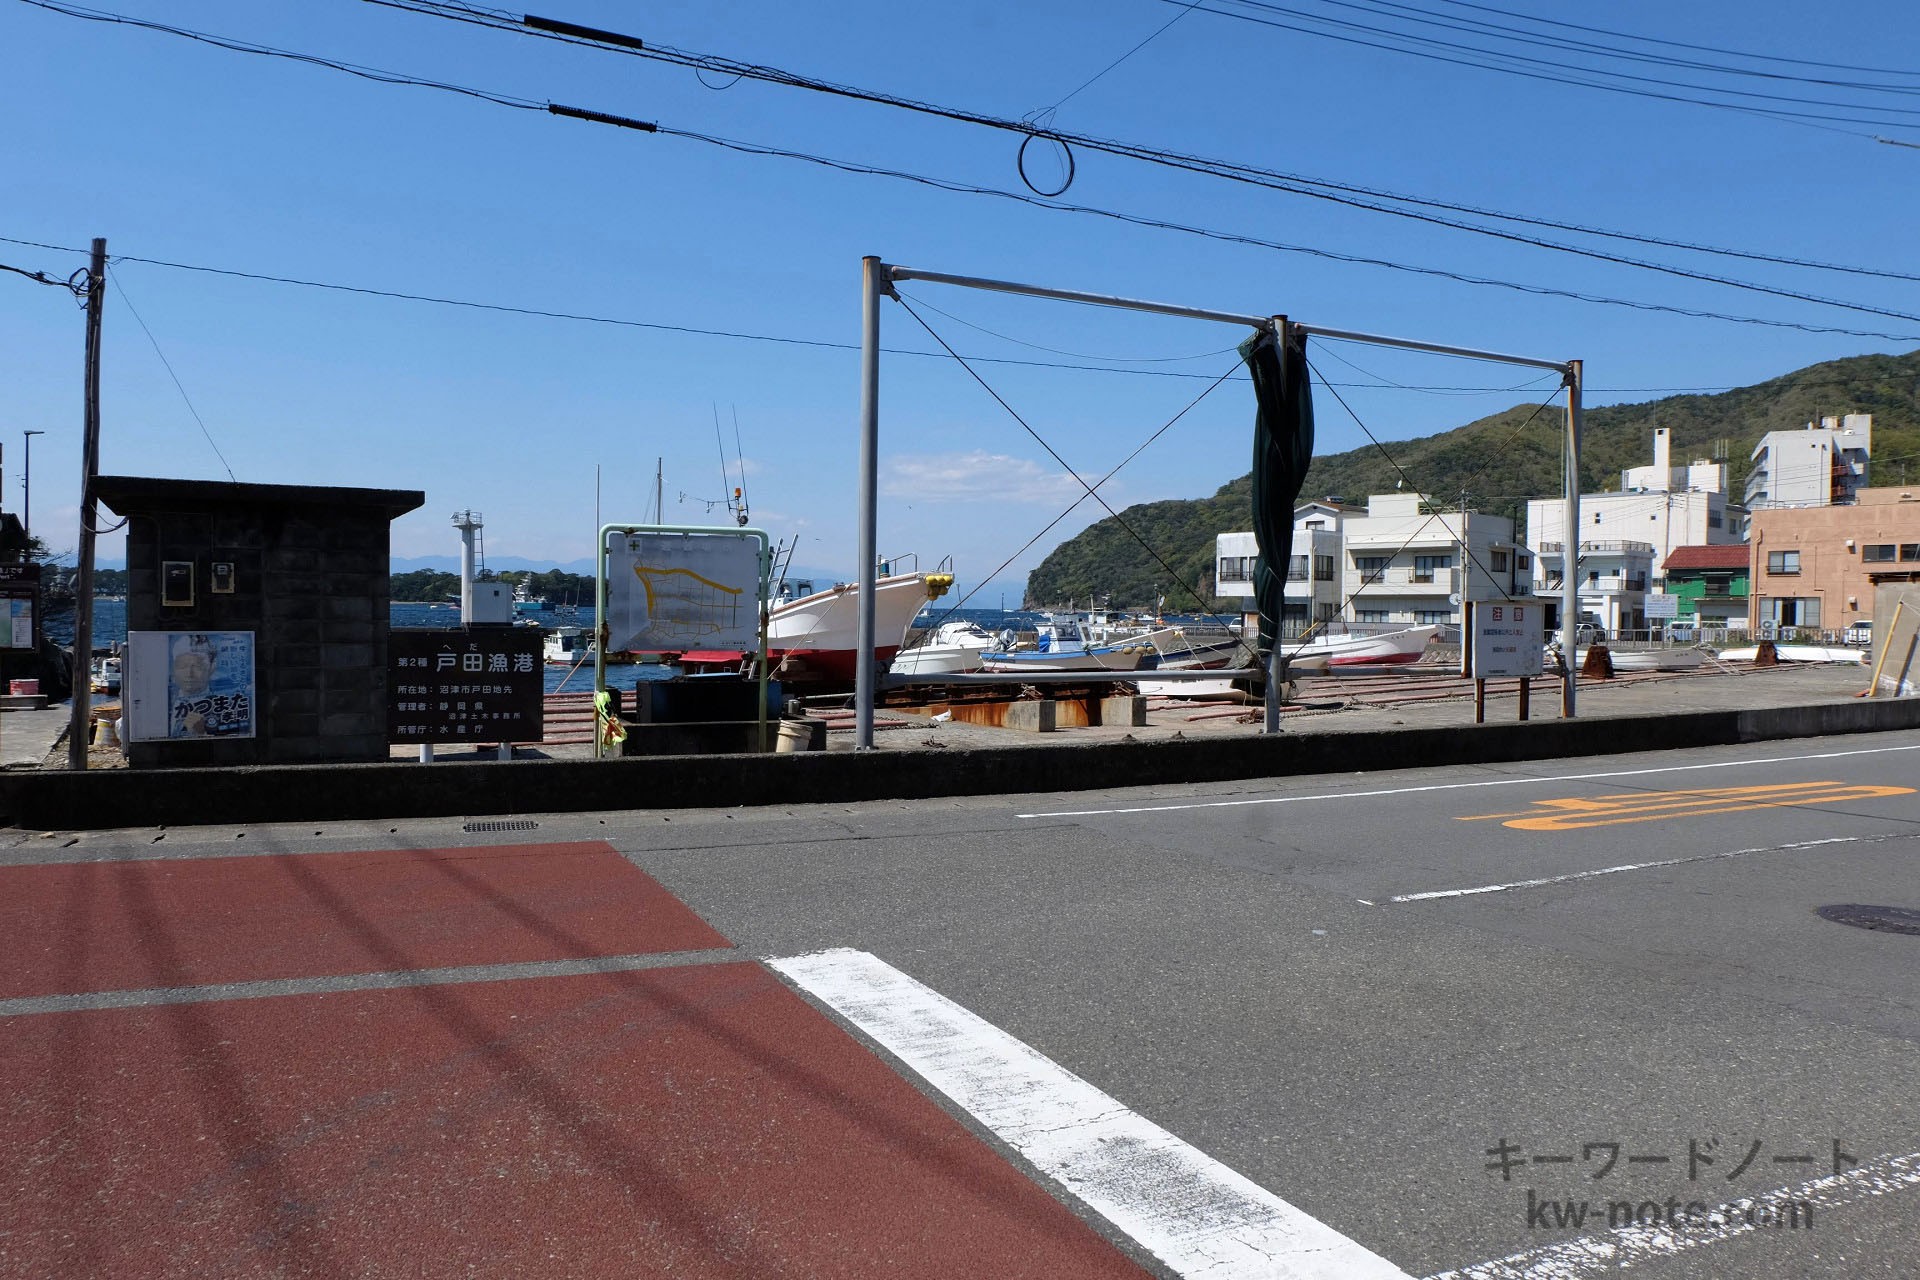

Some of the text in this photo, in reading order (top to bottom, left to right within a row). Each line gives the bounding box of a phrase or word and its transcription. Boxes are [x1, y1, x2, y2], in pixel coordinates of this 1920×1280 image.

[397, 653, 534, 673] 第2種 戸田漁港
[439, 685, 513, 694] 沼津市戸田地先
[174, 692, 250, 719] かつまた
[439, 702, 484, 711] 静岡県
[439, 725, 484, 734] 水産庁
